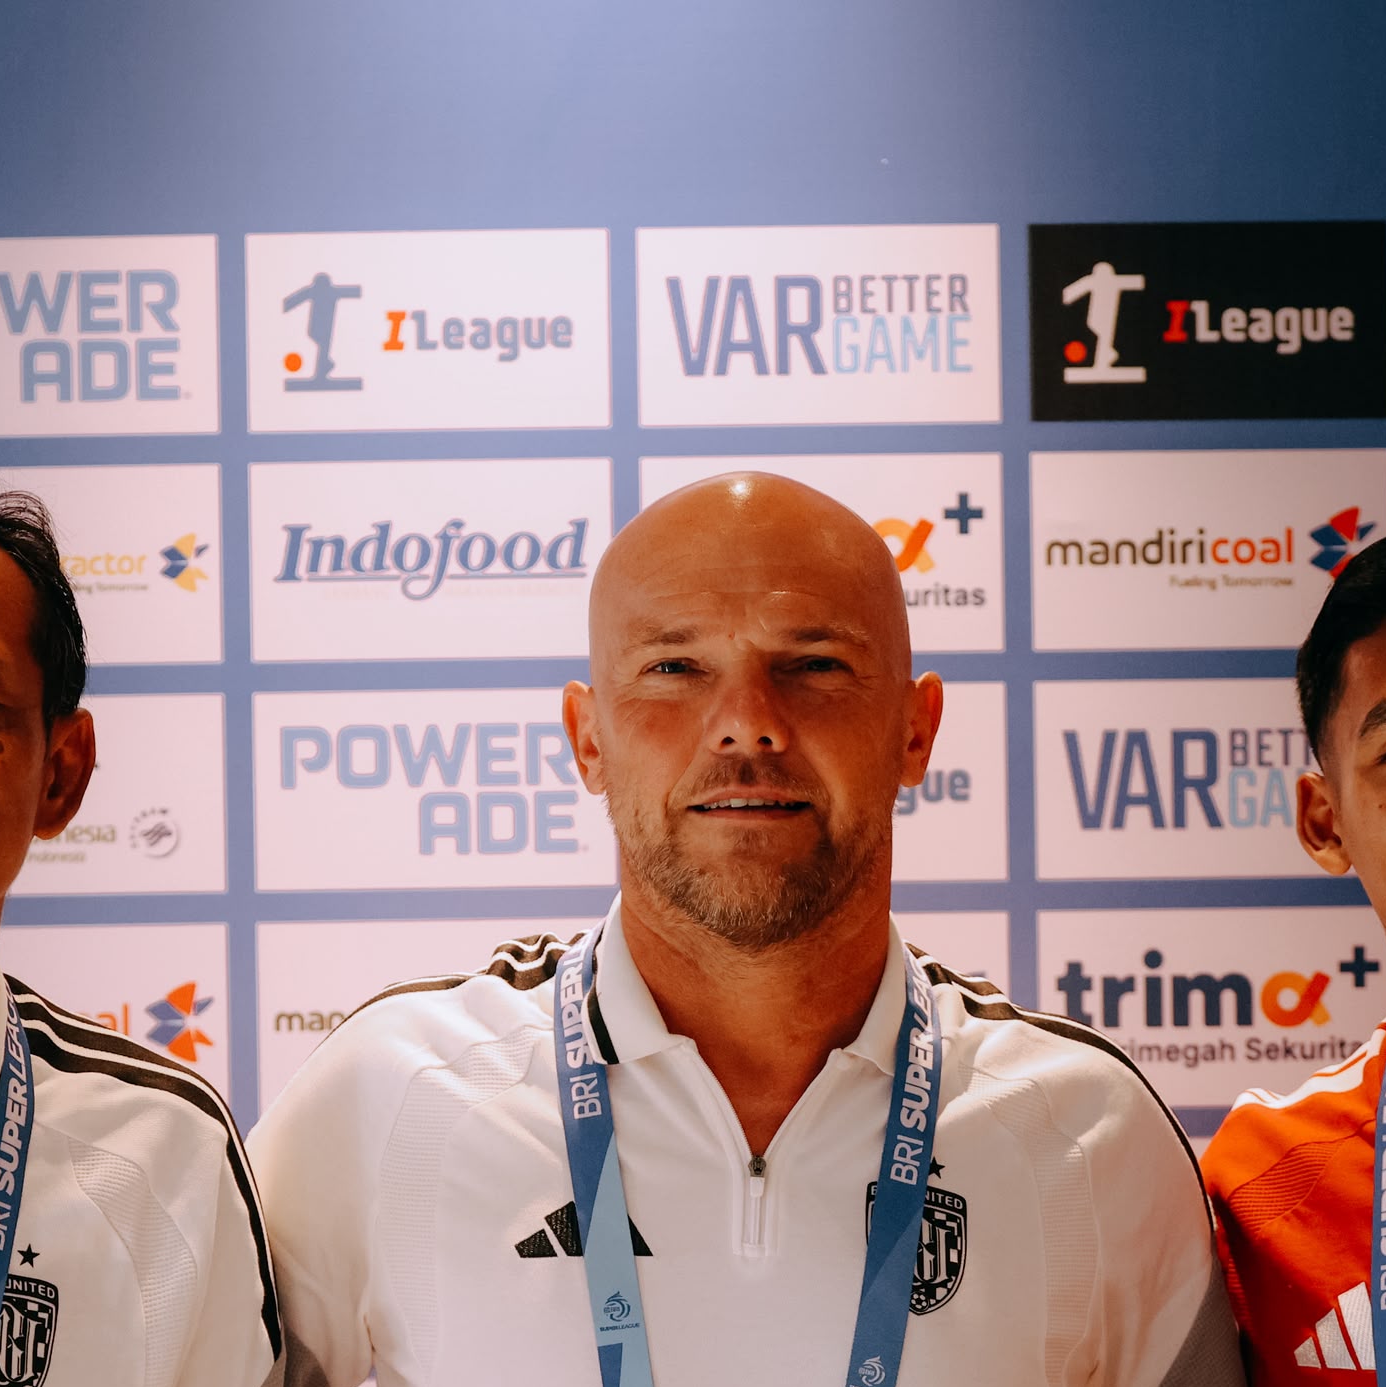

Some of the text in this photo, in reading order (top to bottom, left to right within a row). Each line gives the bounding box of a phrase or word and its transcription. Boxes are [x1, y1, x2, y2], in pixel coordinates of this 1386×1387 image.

[666, 274, 970, 377] VAR BETTER
[831, 314, 973, 375] GAME
[22, 339, 182, 403] ADE
[274, 516, 589, 602] Indofood
[1045, 527, 1294, 567] mandiricoal
[906, 582, 986, 608] uritas
[280, 723, 575, 790] POWER
[1062, 727, 1312, 831] VAR BETT
[419, 791, 580, 856] ADE
[1228, 767, 1294, 829] GA
[1125, 1036, 1363, 1068] rimegah Sekurita
[569, 1072, 602, 1120] BRI
[889, 1134, 924, 1186] BRI
[923, 1190, 963, 1211] NITED
